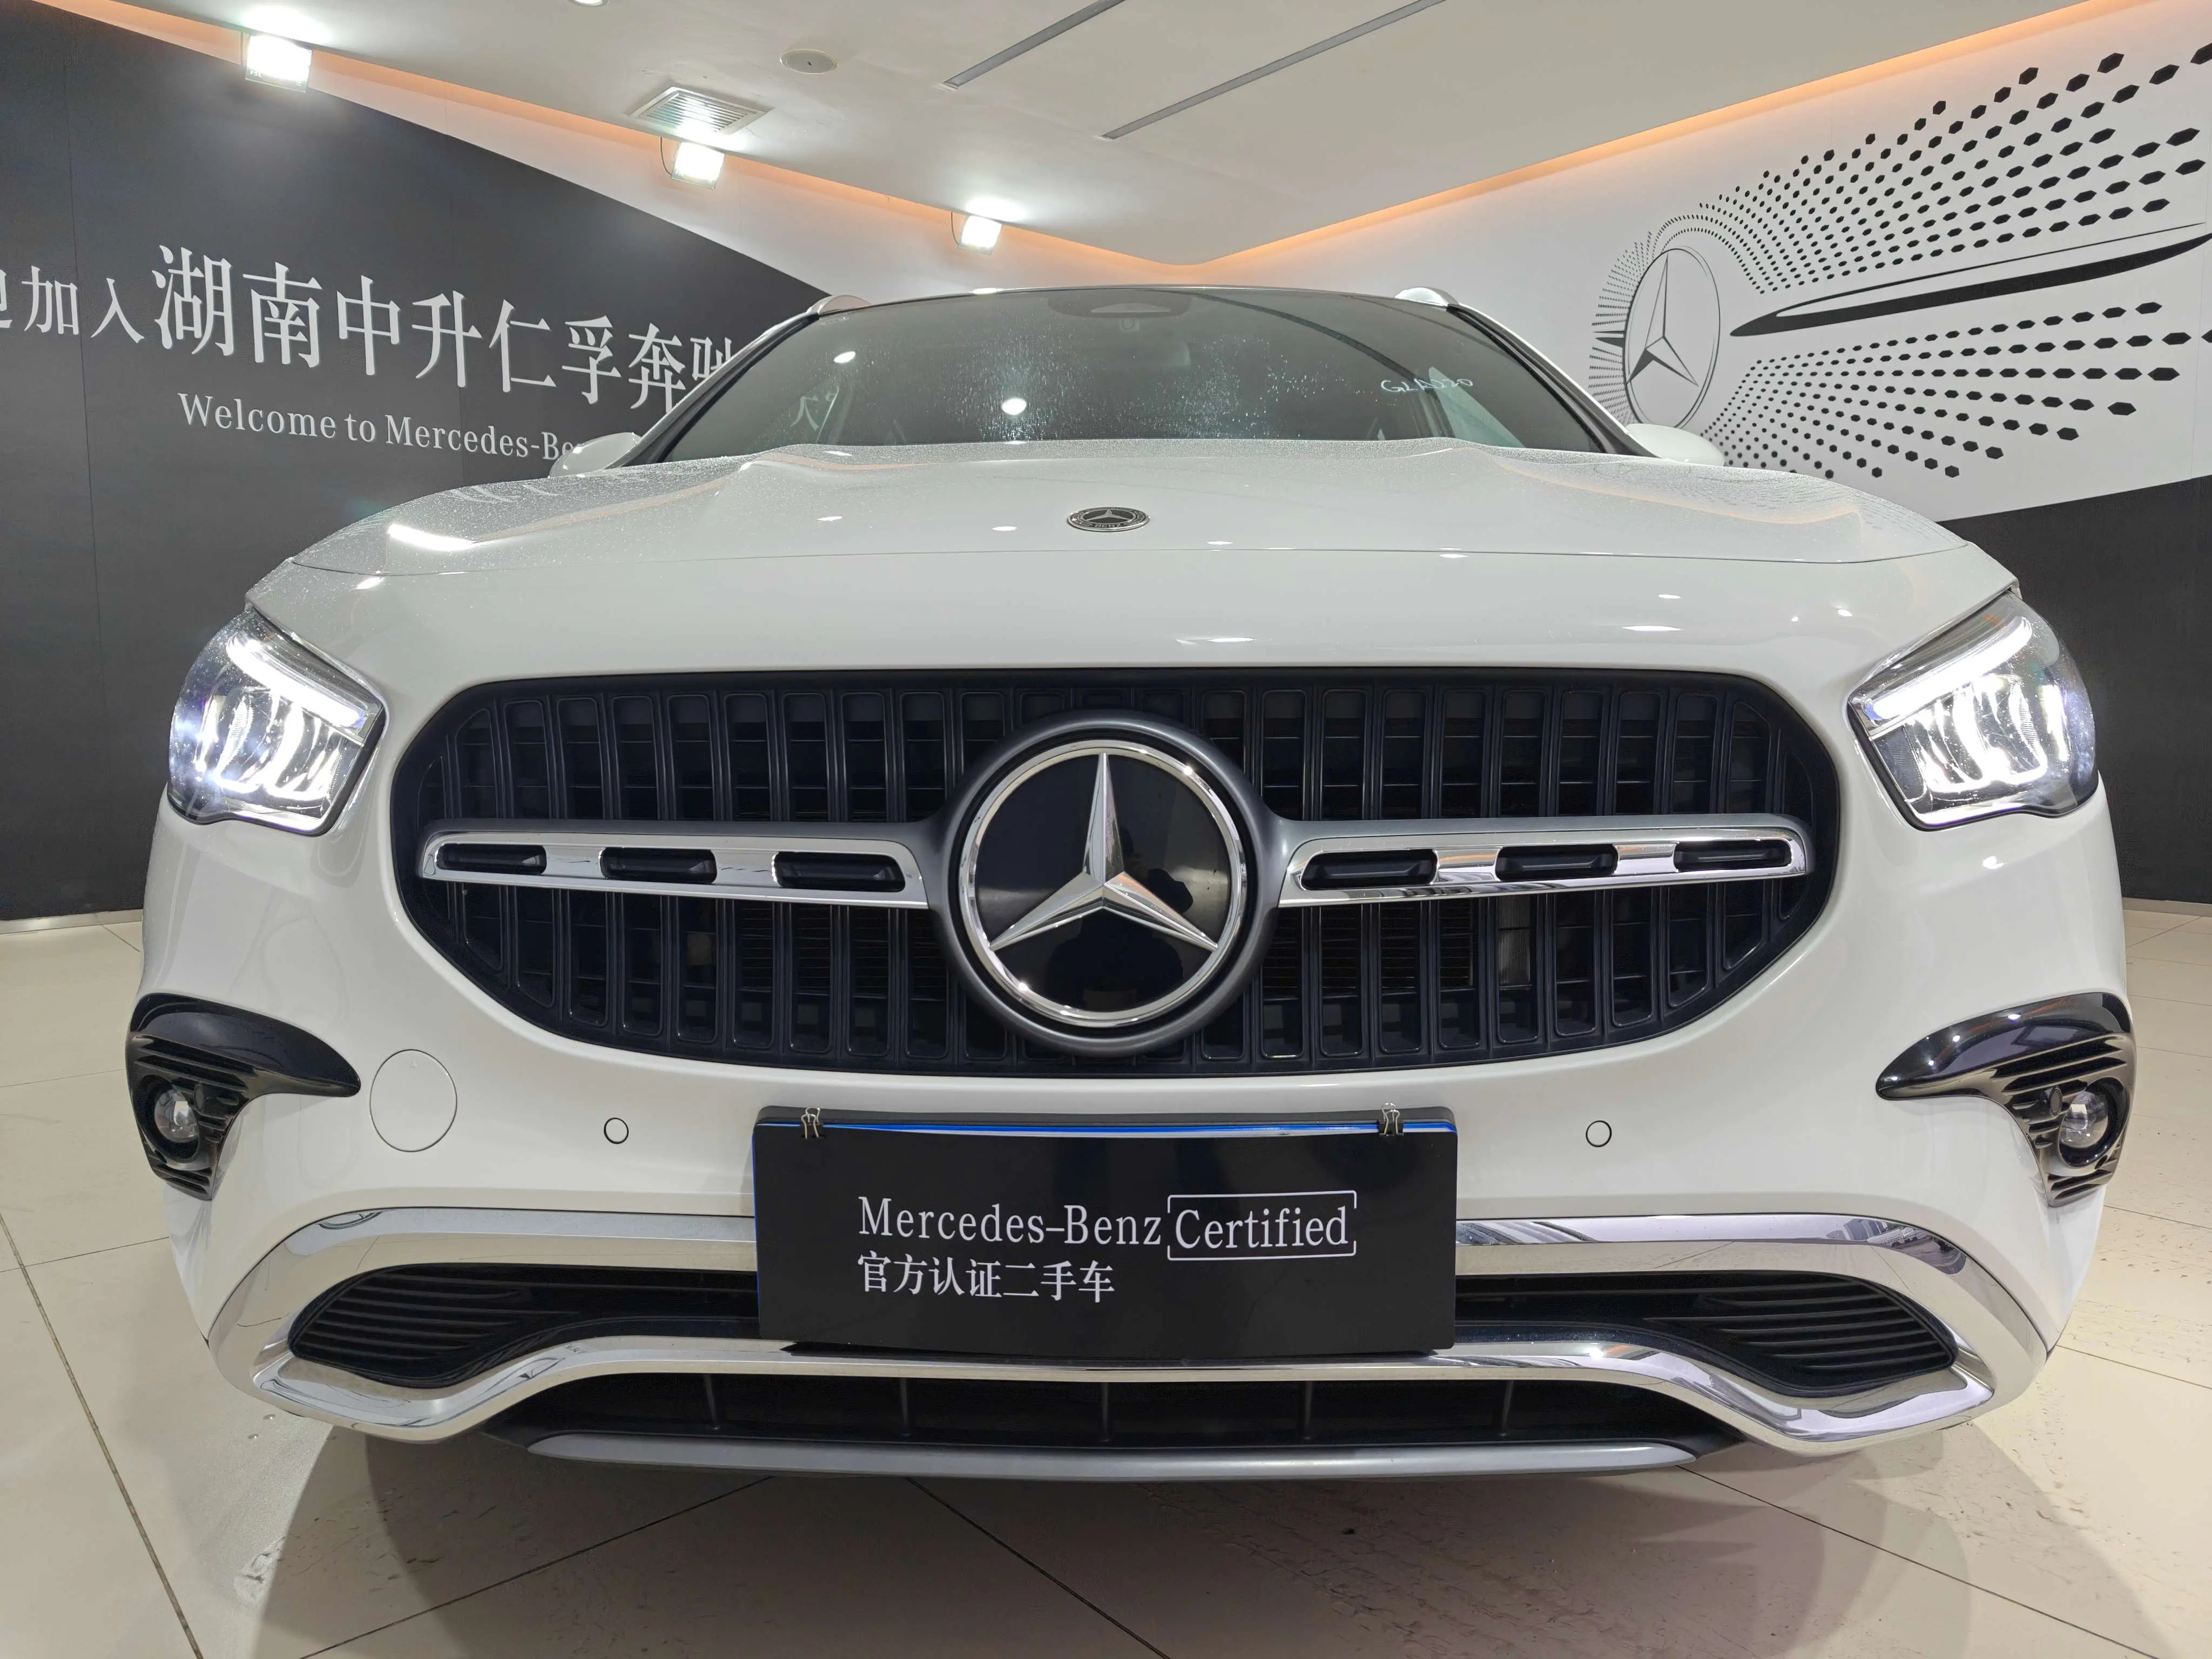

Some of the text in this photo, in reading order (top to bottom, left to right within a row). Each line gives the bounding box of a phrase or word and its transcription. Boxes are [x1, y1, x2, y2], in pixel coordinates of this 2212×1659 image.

[177, 393, 336, 439] Welcome
[344, 414, 376, 442] to
[858, 1196, 1348, 1249] Mercedes-Benz Certified
[858, 1250, 1115, 1303] 官方认证二手车
